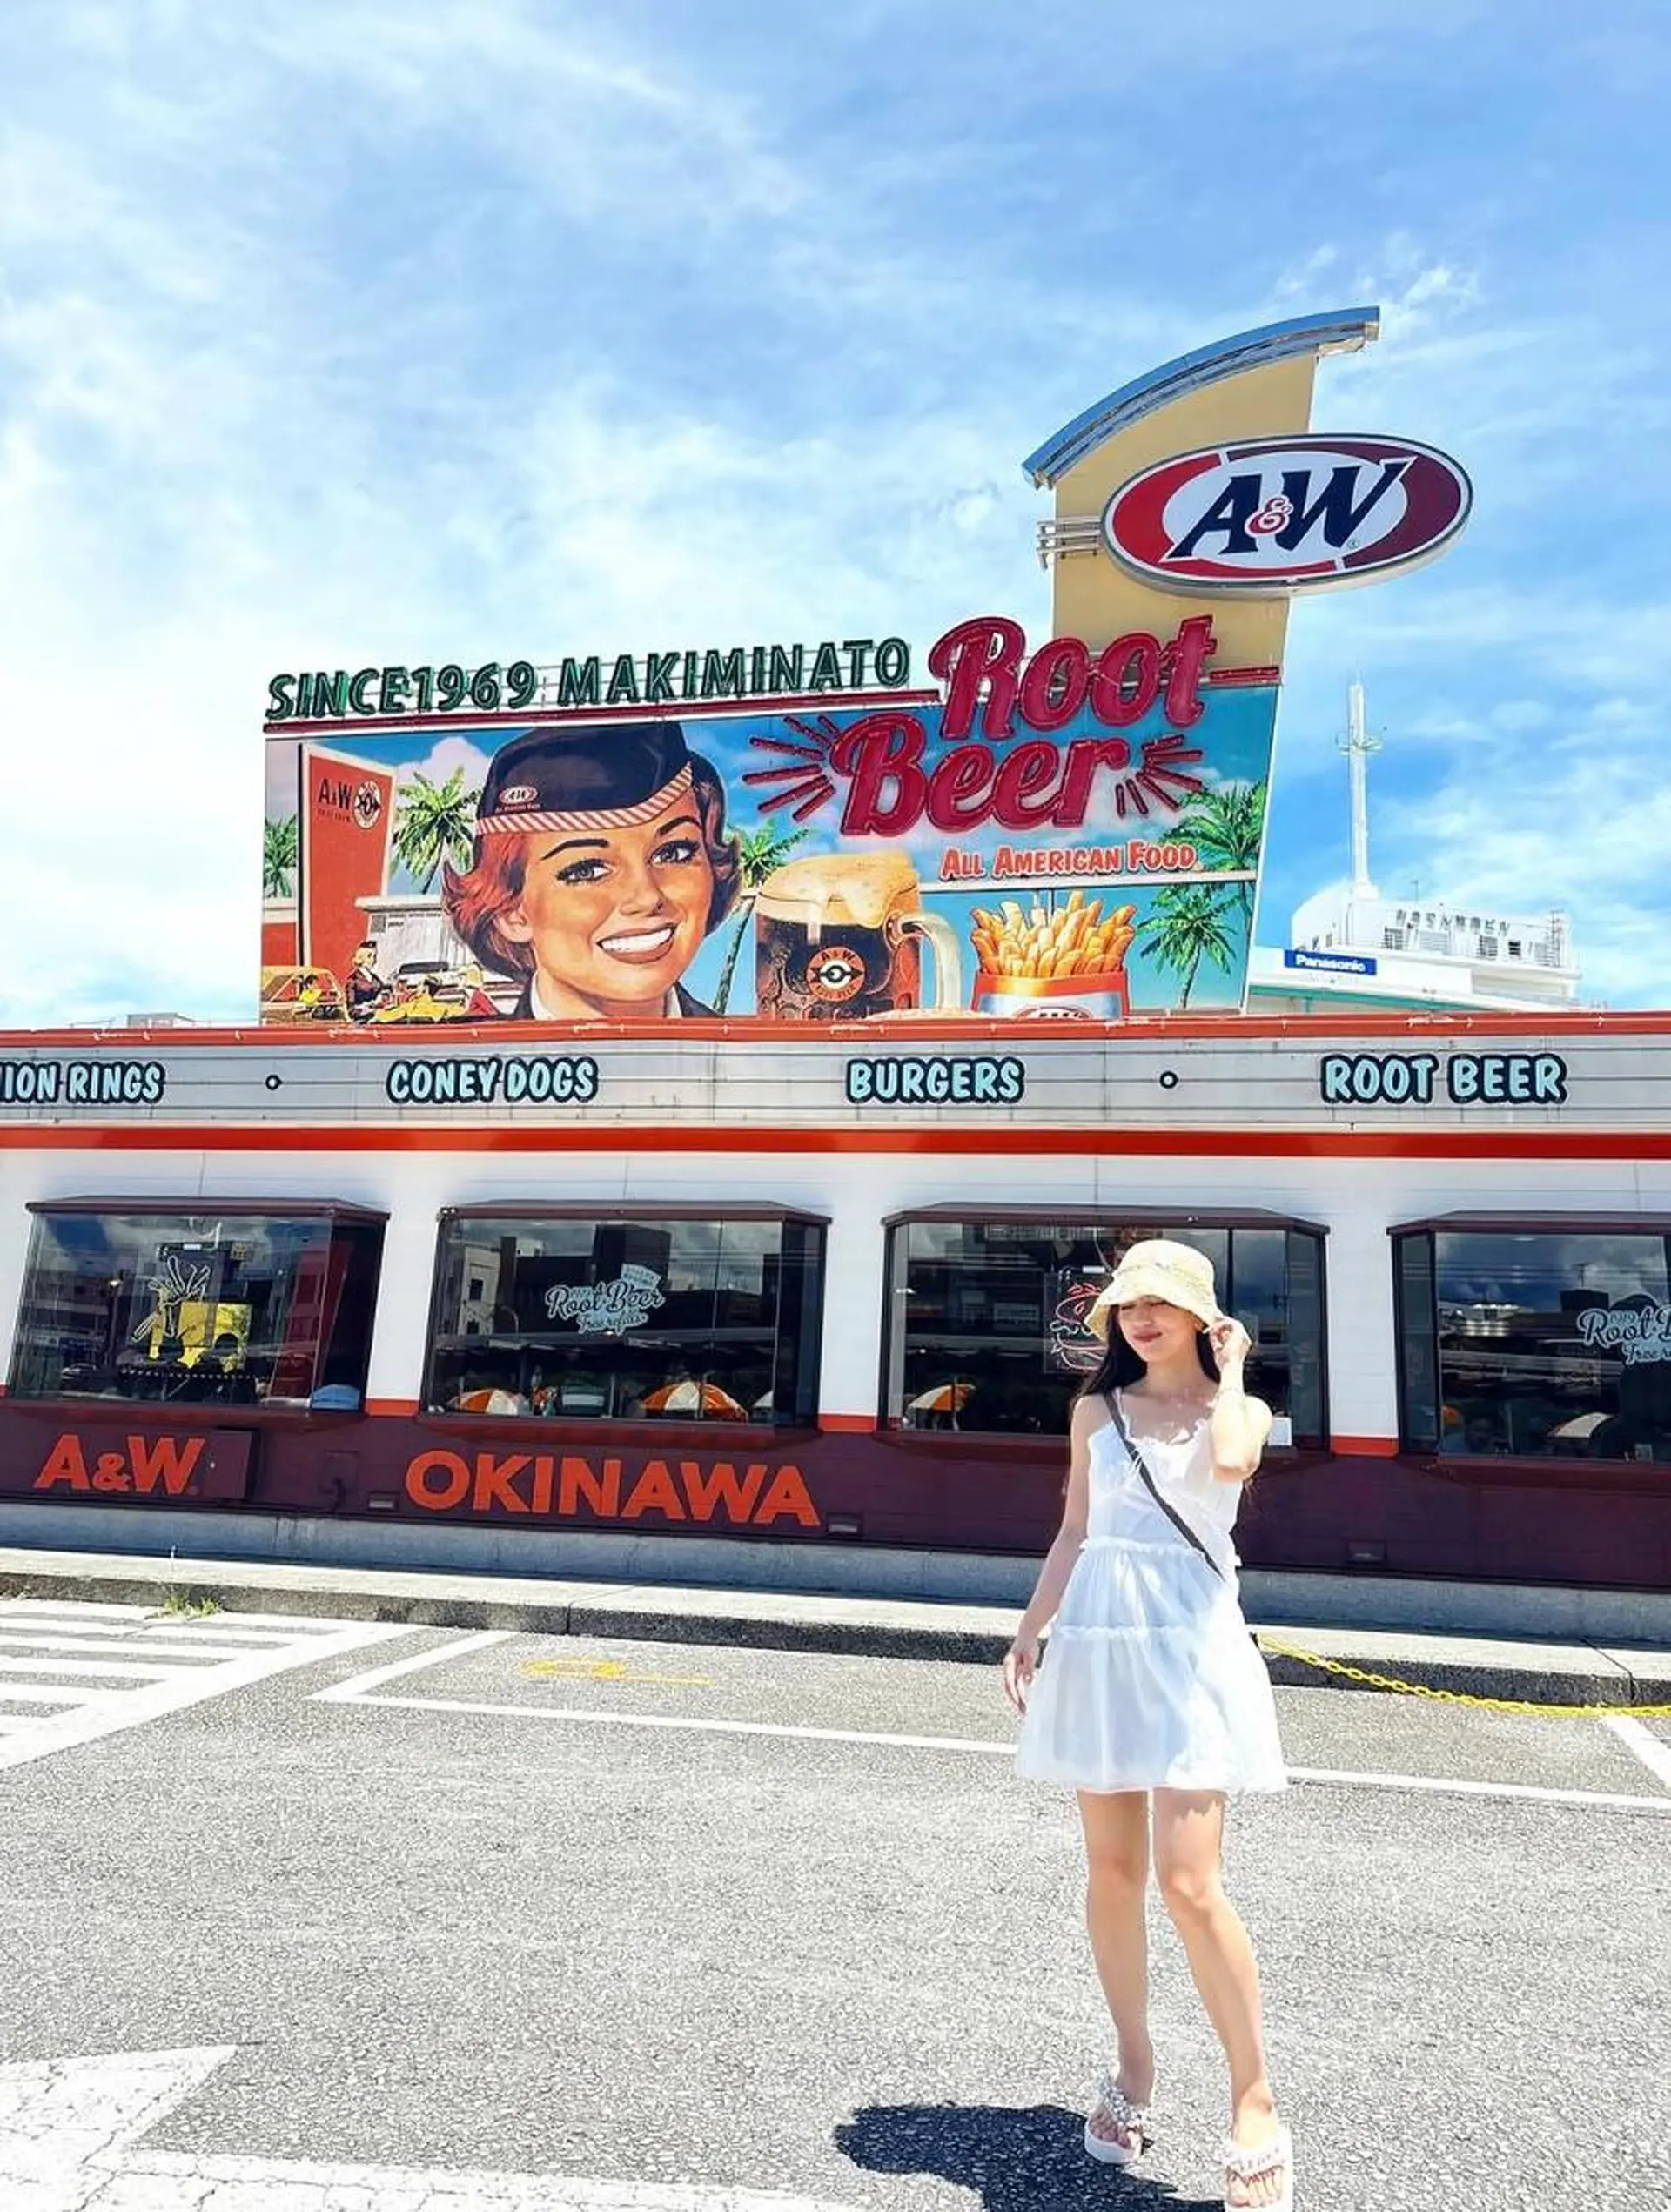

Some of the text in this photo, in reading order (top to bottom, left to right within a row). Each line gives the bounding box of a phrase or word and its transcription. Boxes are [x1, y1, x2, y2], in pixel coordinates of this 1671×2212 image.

[1167, 459, 1414, 559] A&W
[557, 638, 909, 707] MAKIMINATO
[929, 614, 1217, 741] Root
[830, 712, 1130, 838] Beer
[1296, 954, 1366, 973] Panasonic
[0, 1061, 166, 1104] ION RINGS
[386, 1056, 599, 1103] CONEY DOGS
[846, 1056, 1025, 1104] BURGERS
[1320, 1054, 1567, 1104] ROOT BEER
[32, 1433, 206, 1494] A&W
[405, 1449, 822, 1527] OKINAWA
